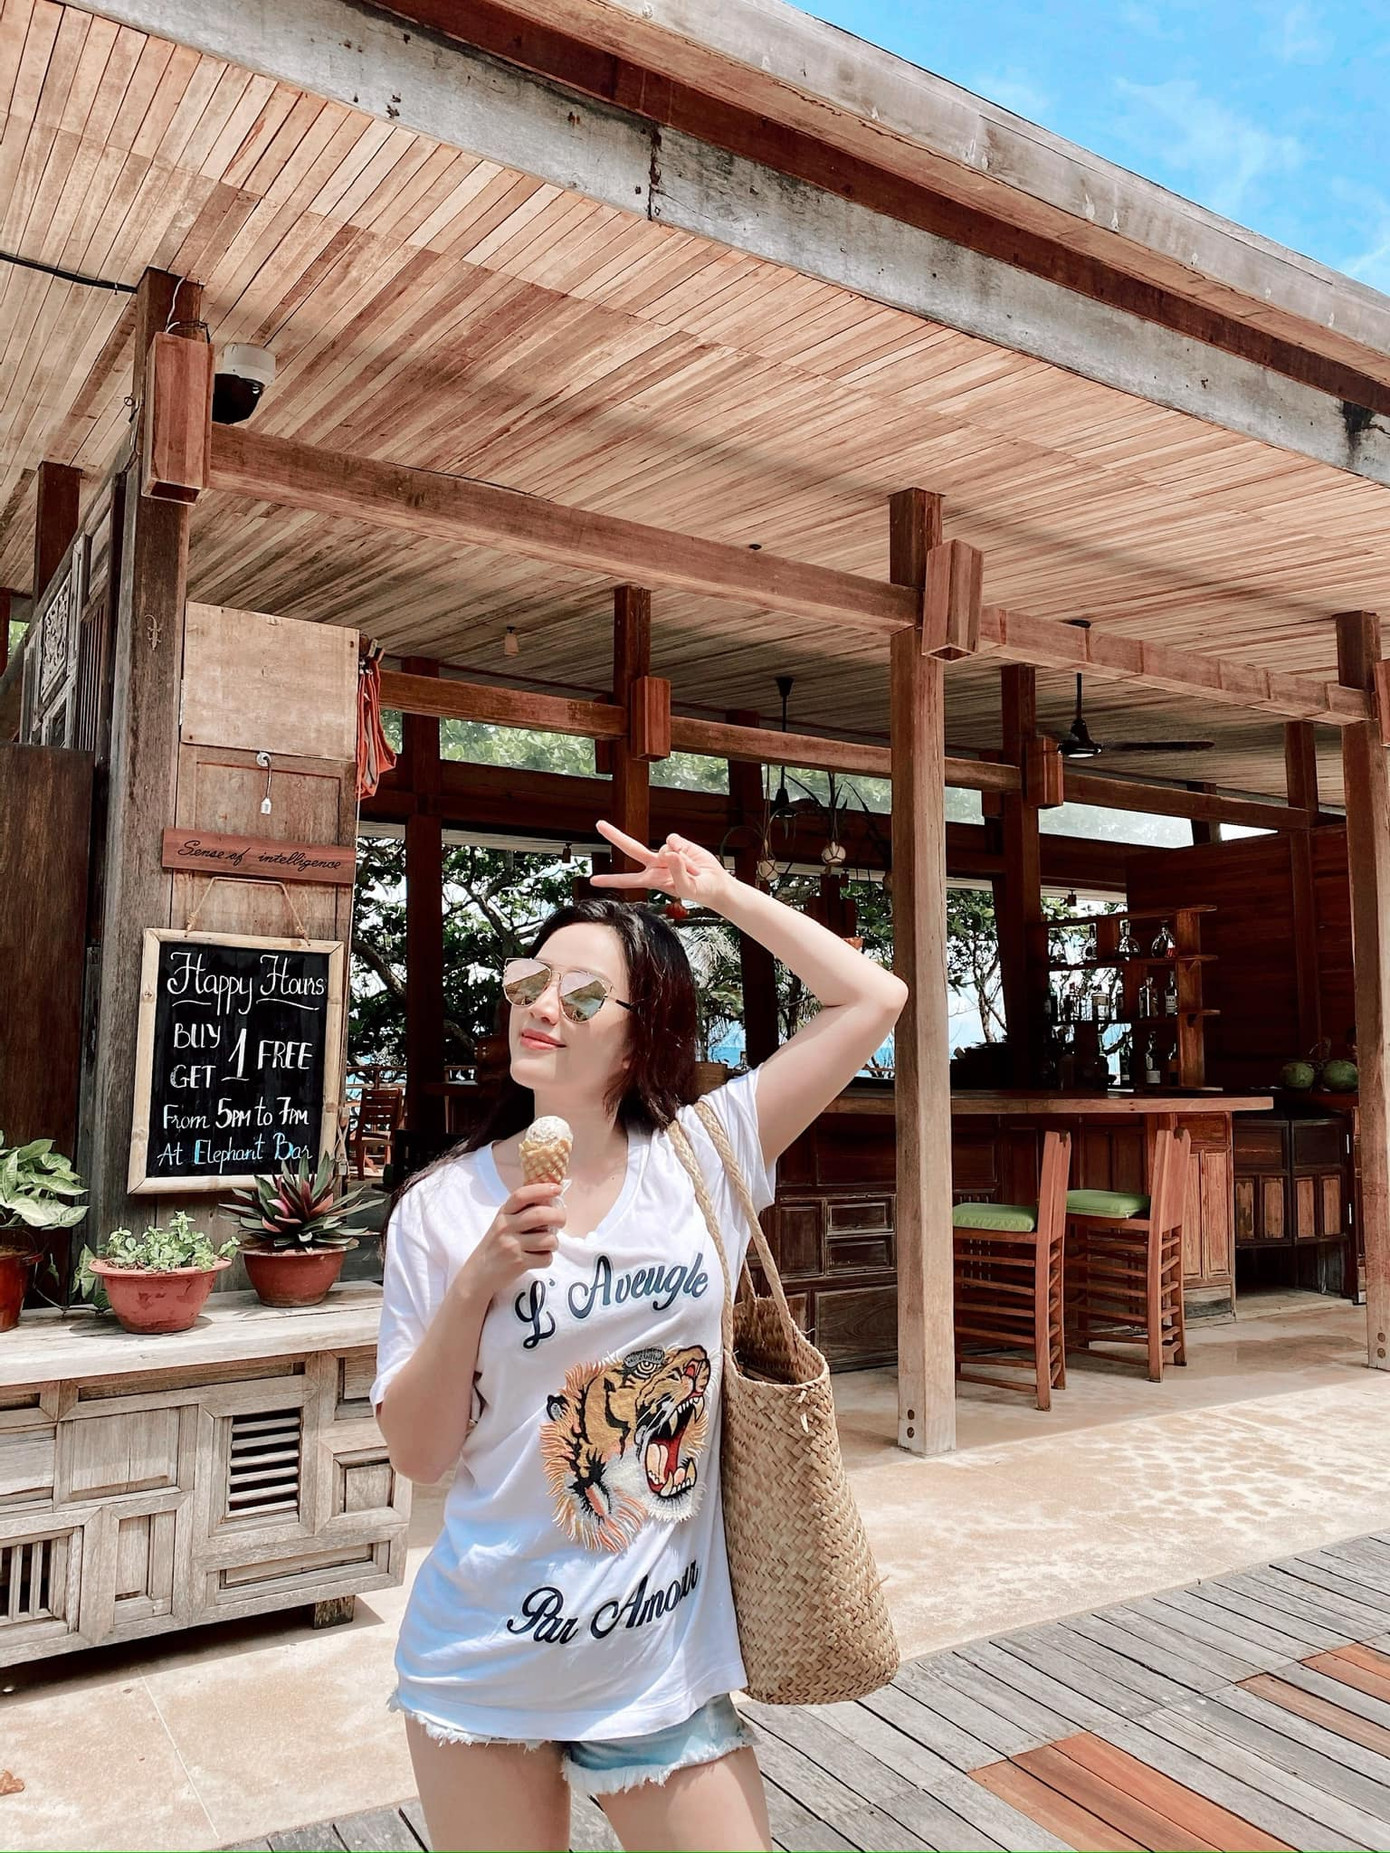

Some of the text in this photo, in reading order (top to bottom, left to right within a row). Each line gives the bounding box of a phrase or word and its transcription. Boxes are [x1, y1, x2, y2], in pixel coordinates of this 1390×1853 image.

[178, 840, 342, 872] Sense of intelligence
[166, 951, 253, 1016] Happy
[173, 1022, 313, 1082] BUY 1 FREE
[169, 1064, 217, 1089] GET
[163, 1104, 211, 1130] From
[254, 1096, 273, 1127] to
[157, 1132, 314, 1175] At Elephant Bar
[506, 1559, 699, 1645] Par Amour
